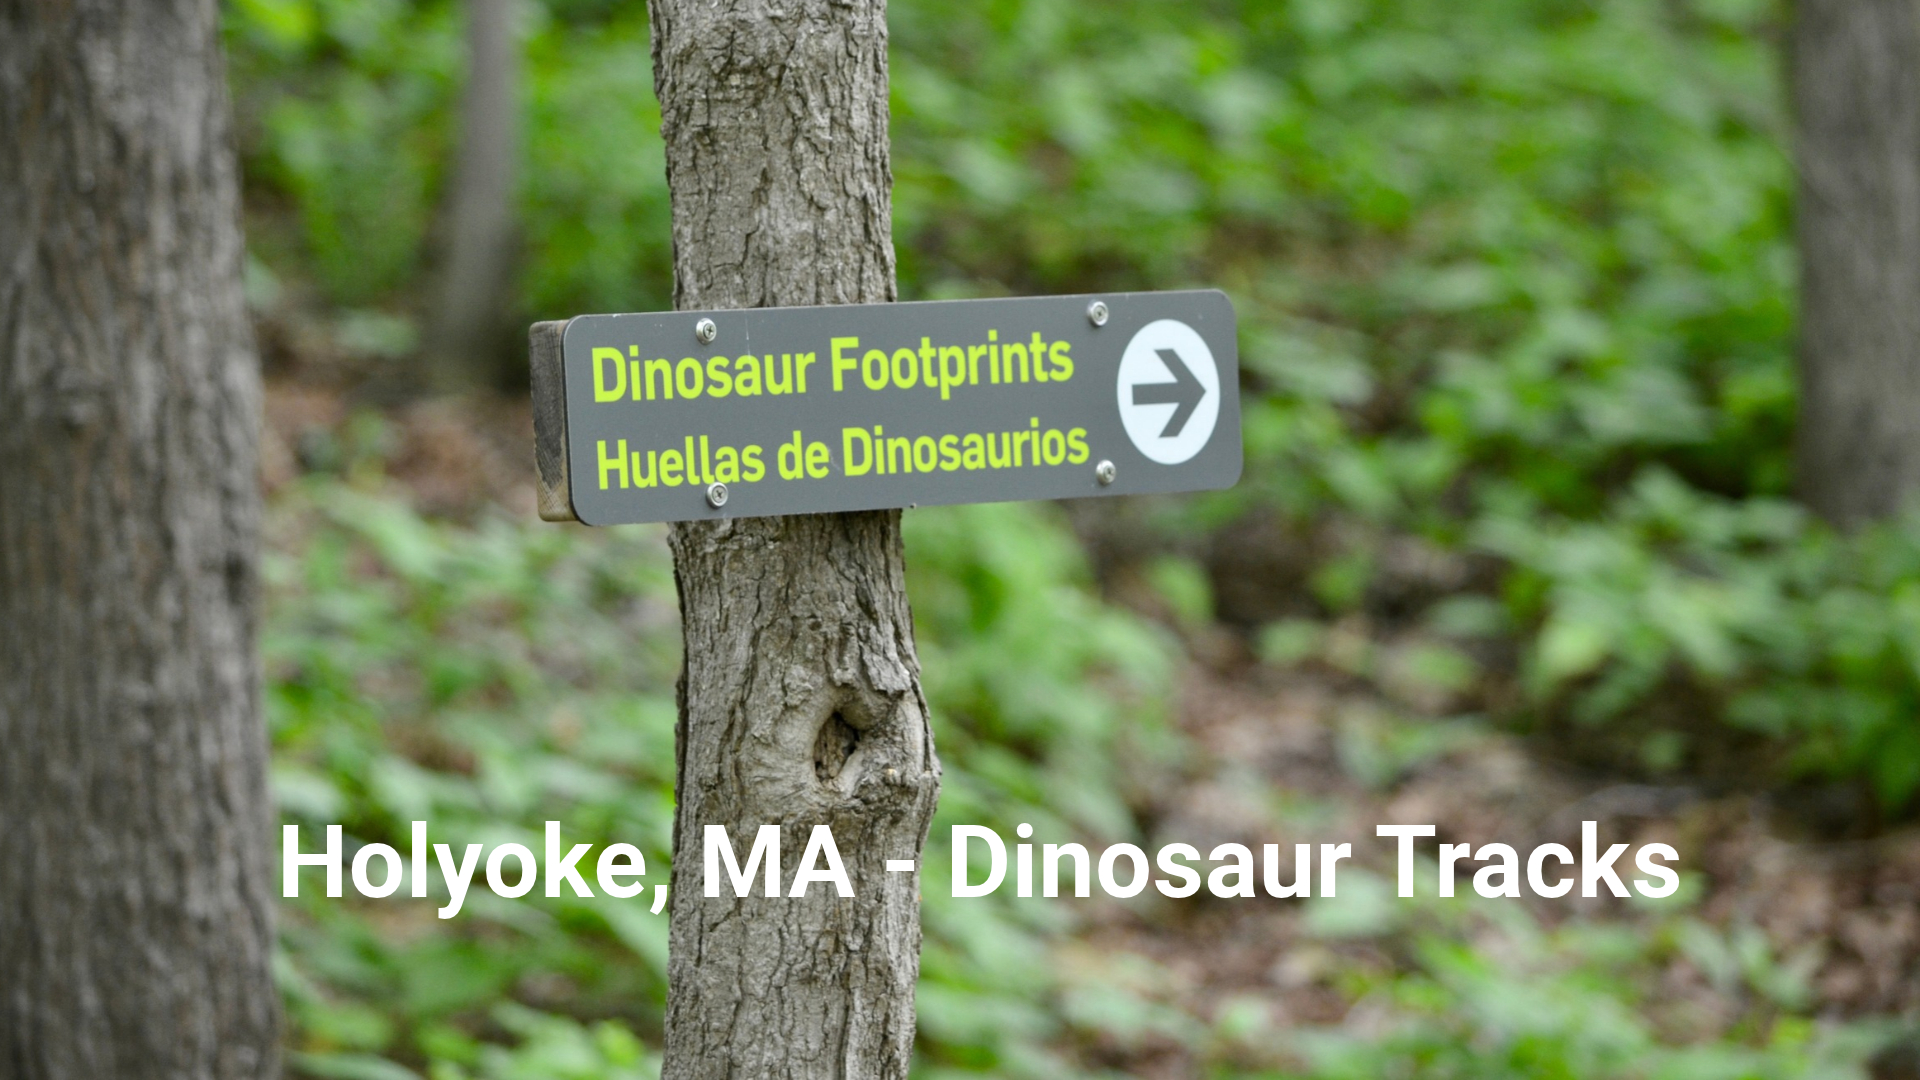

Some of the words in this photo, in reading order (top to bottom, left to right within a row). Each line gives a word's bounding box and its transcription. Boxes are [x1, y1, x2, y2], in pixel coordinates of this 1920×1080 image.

[592, 345, 817, 403] Dinosaur
[830, 329, 1074, 401] Footprints
[597, 434, 765, 490] Huellas
[777, 430, 830, 481] de
[842, 417, 1090, 477] Dinosaurios
